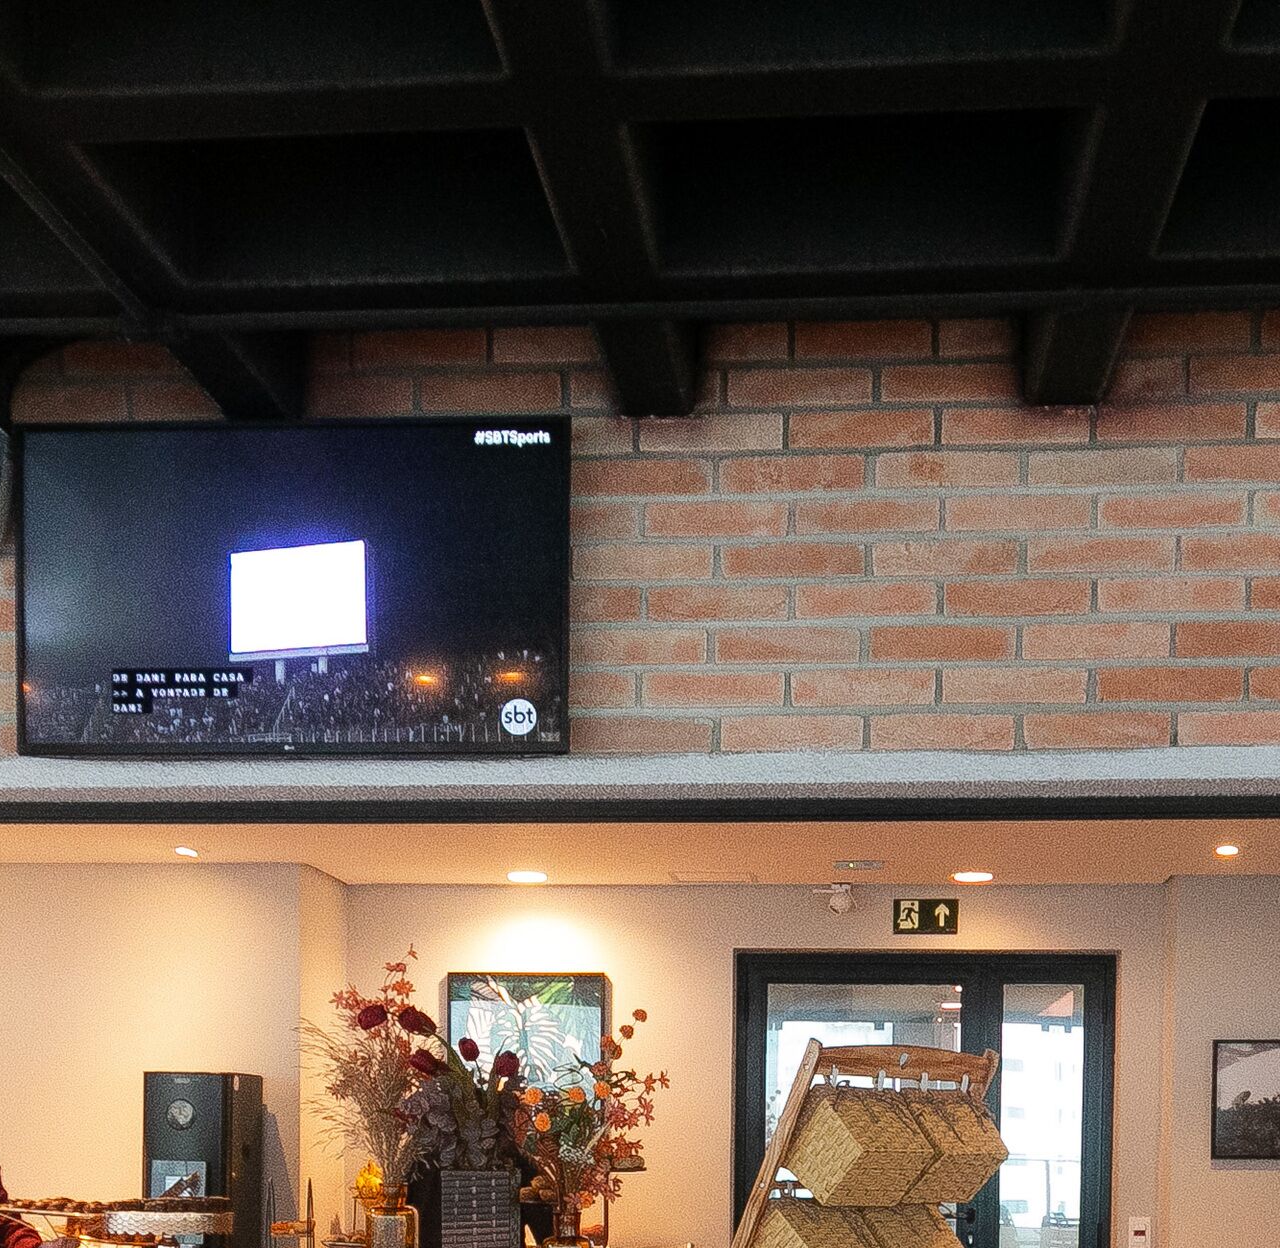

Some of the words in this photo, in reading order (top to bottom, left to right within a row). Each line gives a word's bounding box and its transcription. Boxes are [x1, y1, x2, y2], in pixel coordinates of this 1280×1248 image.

[474, 430, 551, 448] #SBTSports
[174, 673, 206, 683] PARA
[213, 673, 245, 683] CASA
[151, 688, 206, 698] VONTADE
[504, 705, 534, 724] sbt
